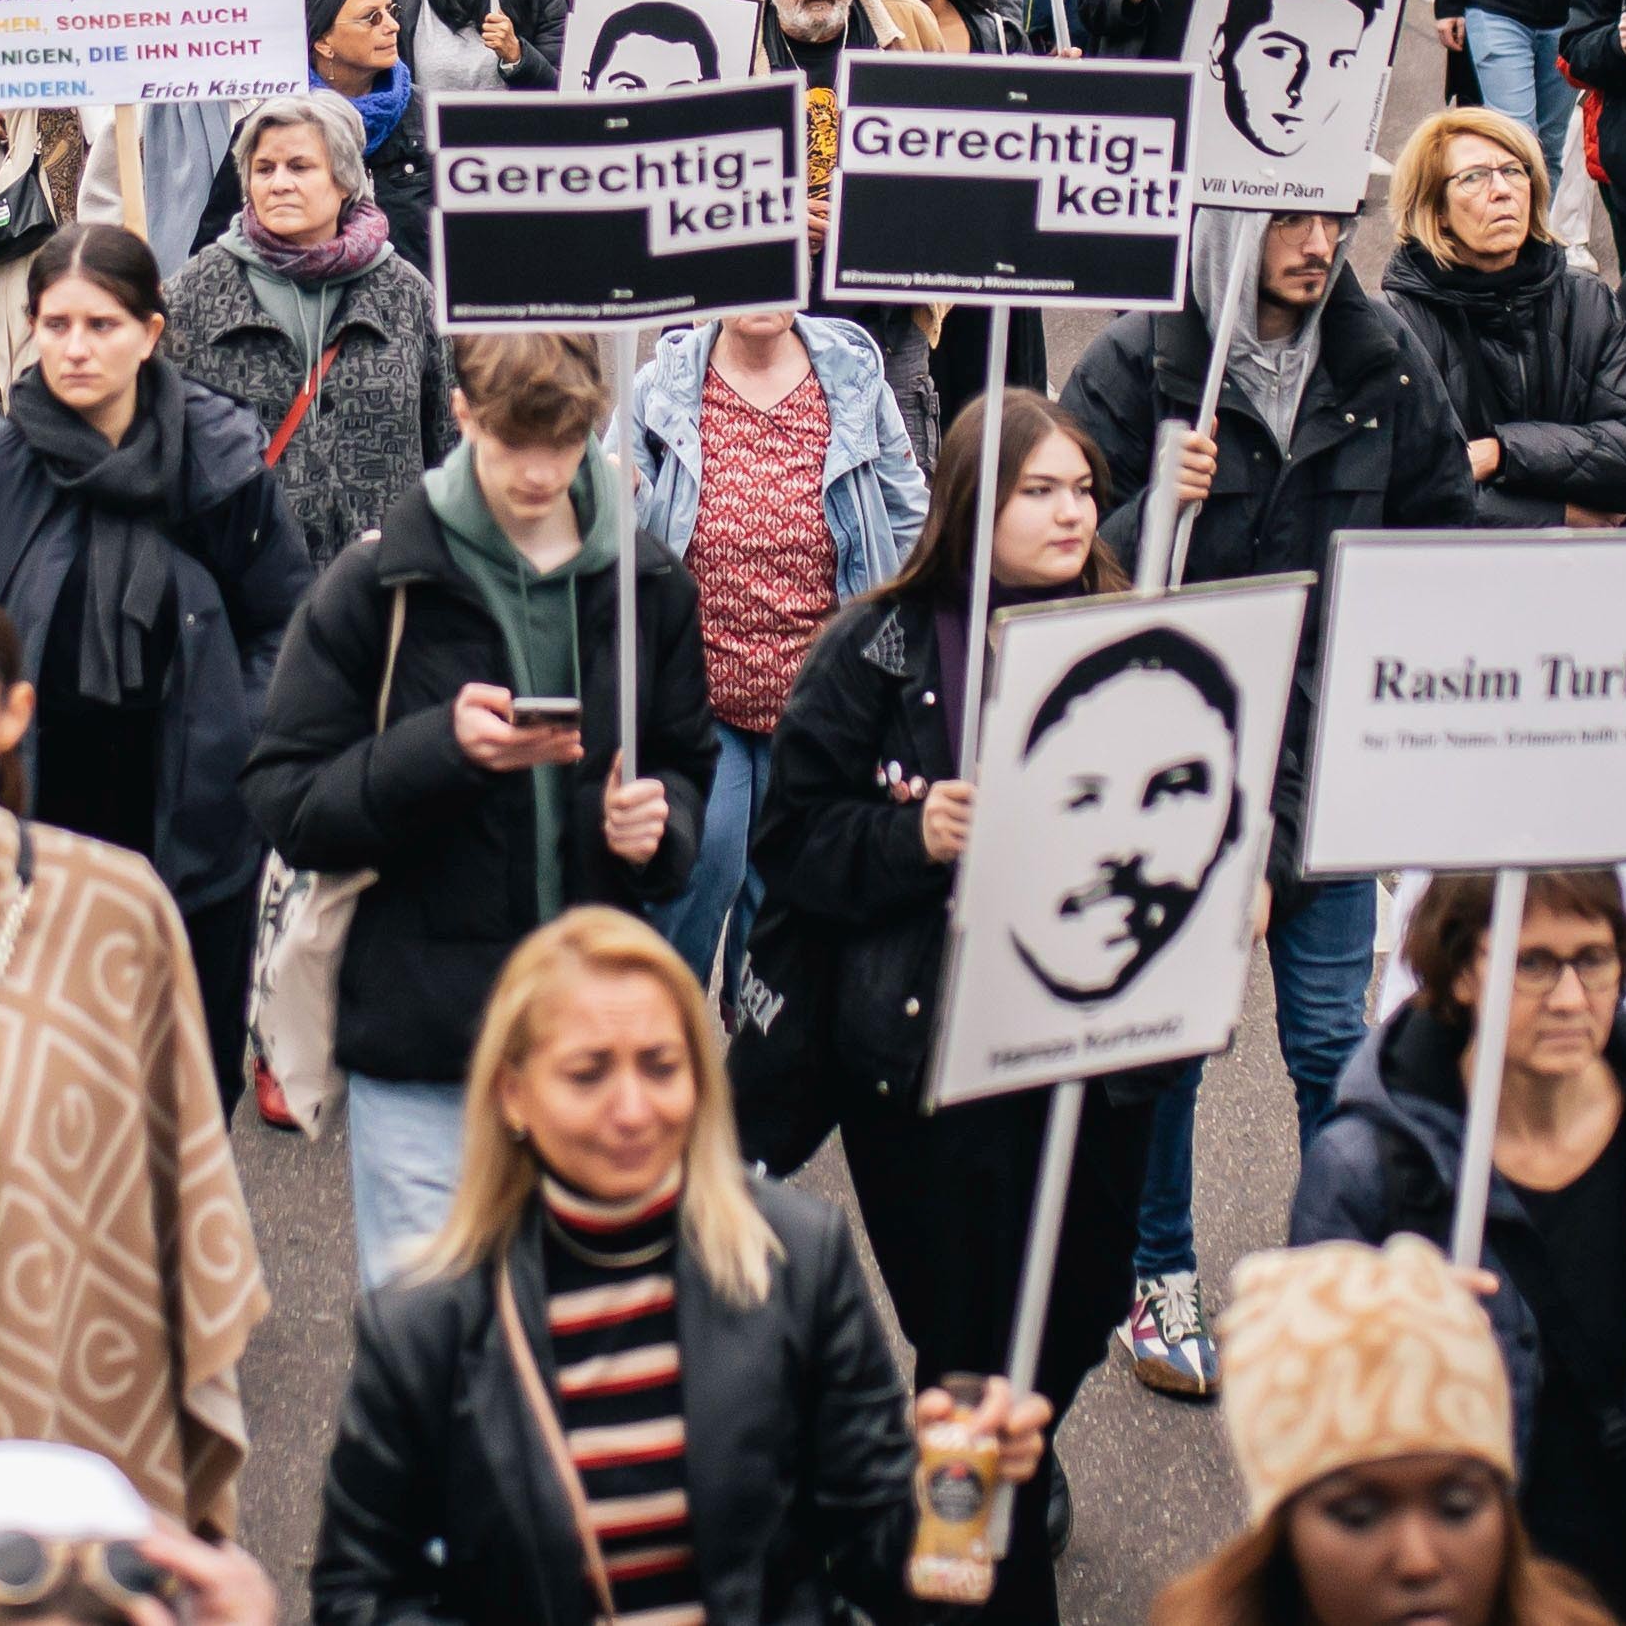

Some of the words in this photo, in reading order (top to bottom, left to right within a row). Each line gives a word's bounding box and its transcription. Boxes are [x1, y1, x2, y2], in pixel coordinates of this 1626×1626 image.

[56, 10, 172, 31] SONDERN
[180, 5, 249, 26] AUCH
[89, 44, 129, 64] DIE
[136, 41, 178, 61] IHN
[187, 38, 263, 59] NICHT
[140, 80, 206, 101] Erich
[209, 77, 301, 100] Kästner
[853, 116, 1164, 174] Gerechtig-
[448, 149, 774, 195] Gerechtig-
[1201, 177, 1226, 193] Vili
[1231, 180, 1280, 197] Viorel
[668, 187, 796, 236] keit!
[1057, 177, 1179, 221] keit!
[1370, 655, 1522, 703] Rasim
